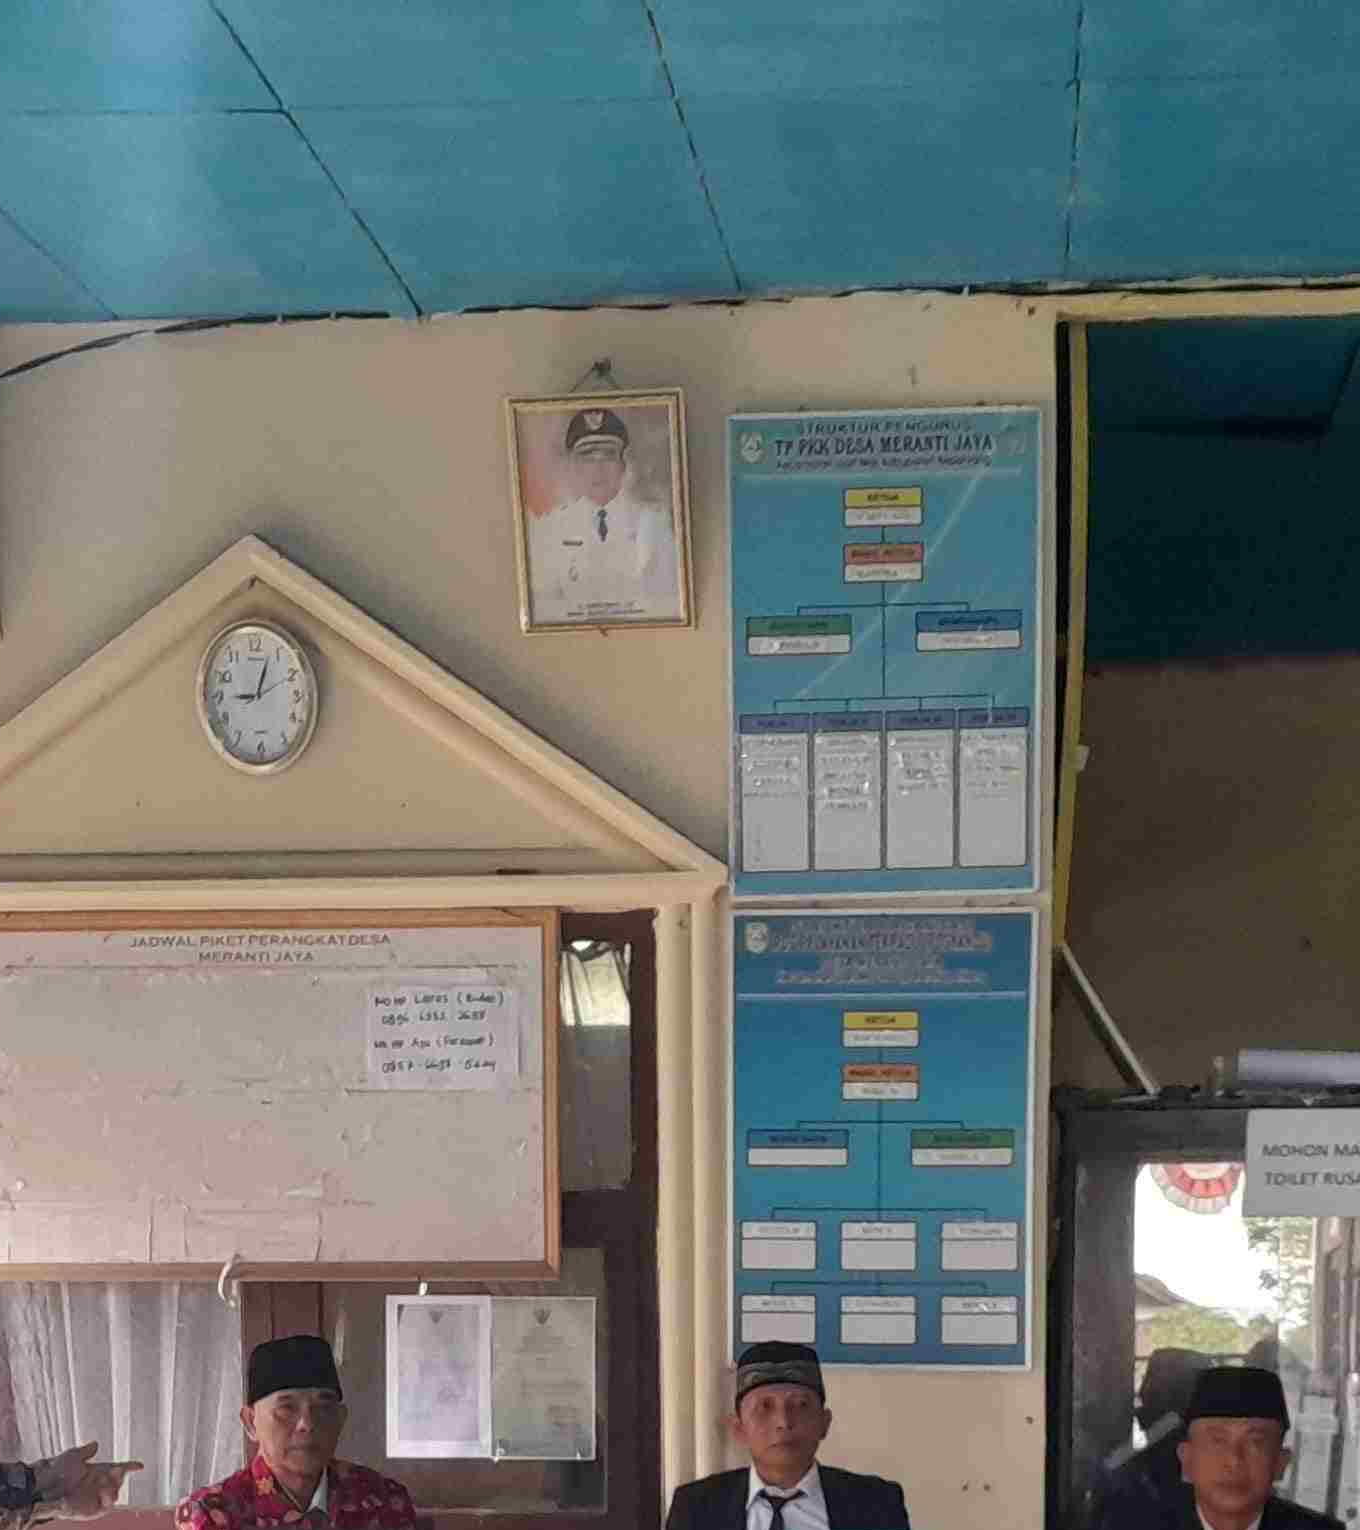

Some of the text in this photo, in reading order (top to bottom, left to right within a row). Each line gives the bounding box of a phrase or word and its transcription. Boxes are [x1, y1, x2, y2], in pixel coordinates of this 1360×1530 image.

[835, 436, 874, 454] DESA
[955, 433, 993, 451] JAYA
[130, 936, 193, 948] JADWAL
[200, 935, 242, 946] PIKET
[348, 934, 390, 946] DESA
[199, 951, 314, 962] MERANTI JAYA
[1264, 1171, 1319, 1186] TOILET
